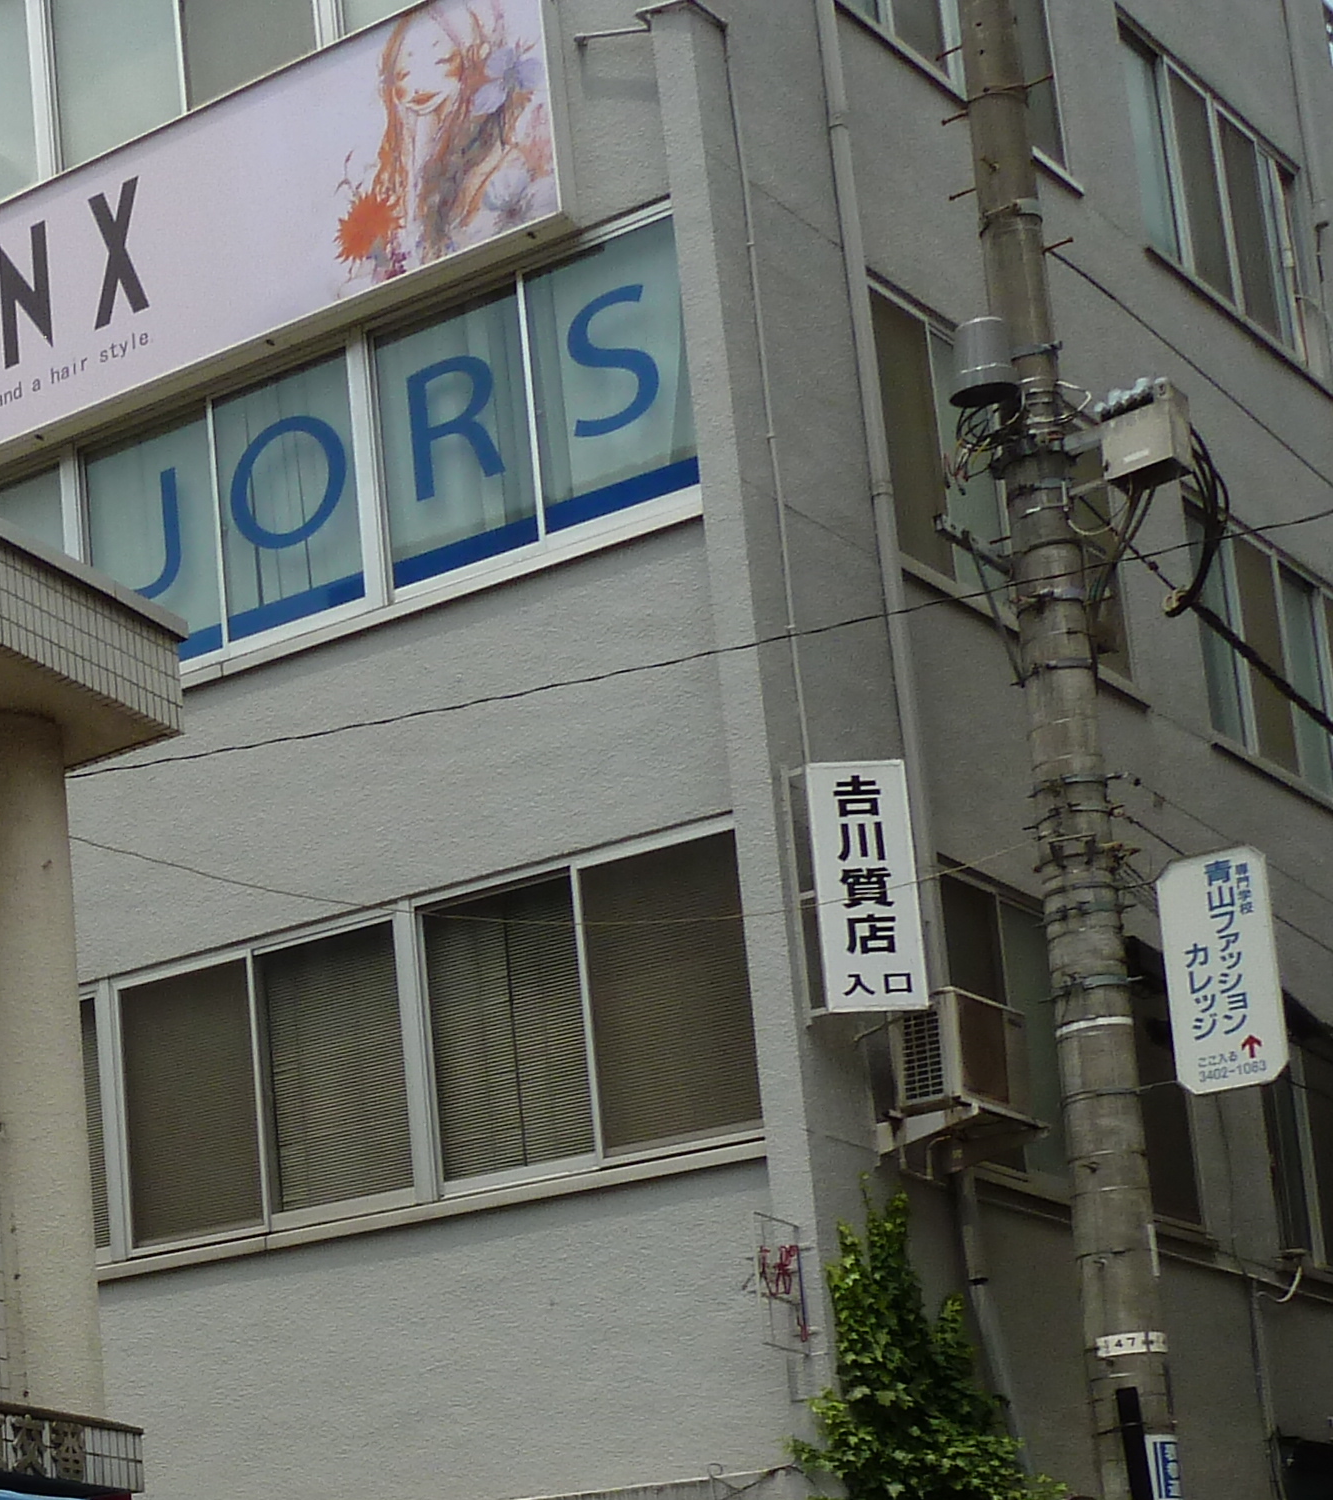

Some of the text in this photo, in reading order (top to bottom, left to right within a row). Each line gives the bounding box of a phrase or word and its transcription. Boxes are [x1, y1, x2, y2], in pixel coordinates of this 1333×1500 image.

[31, 378, 41, 392] a
[50, 356, 88, 384] hair
[1235, 862, 1254, 915] 専門学校
[1203, 859, 1248, 1036] 青山ファッション
[843, 972, 913, 996] 入口
[1185, 942, 1219, 1041] カレッジ
